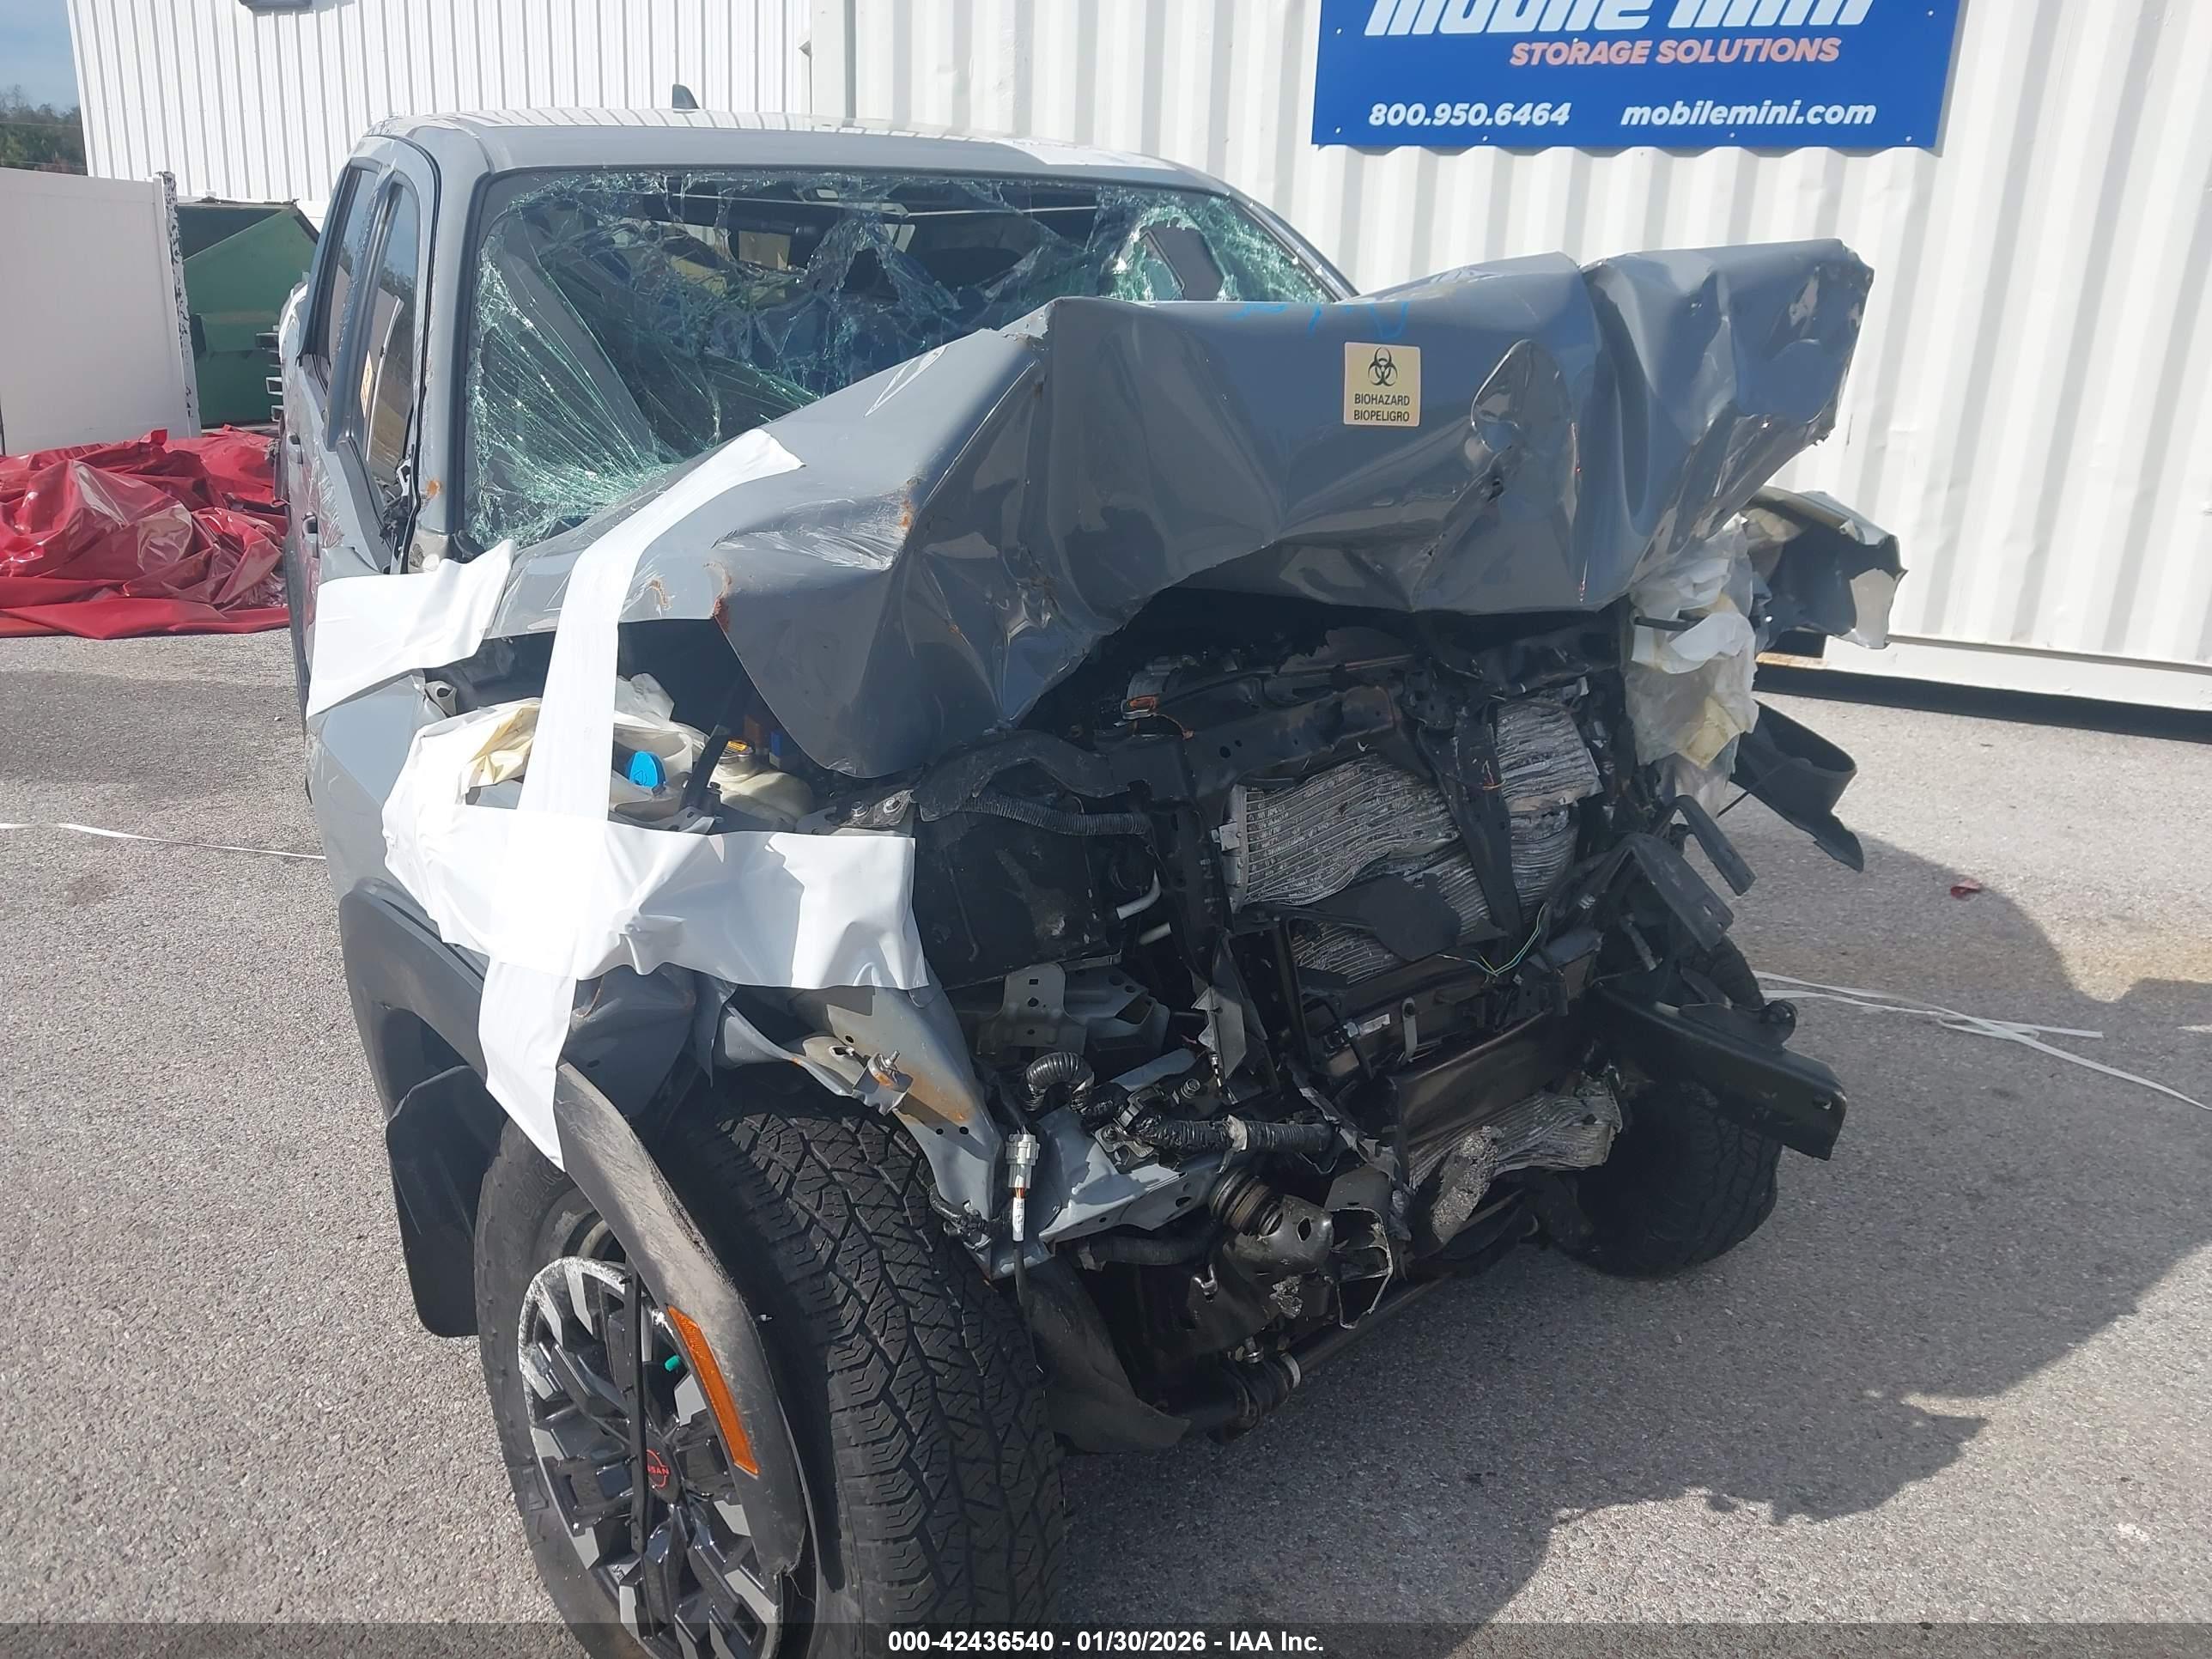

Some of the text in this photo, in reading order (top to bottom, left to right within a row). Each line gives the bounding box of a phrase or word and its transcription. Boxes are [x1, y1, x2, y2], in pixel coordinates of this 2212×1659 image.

[1510, 37, 1842, 66] STORAGE SOLUTIONS
[1369, 100, 1878, 126] 800.950.6464 mobilemini.com
[1353, 392, 1410, 406] BIOHAZARD
[1353, 409, 1410, 422] BIOPELIGRO
